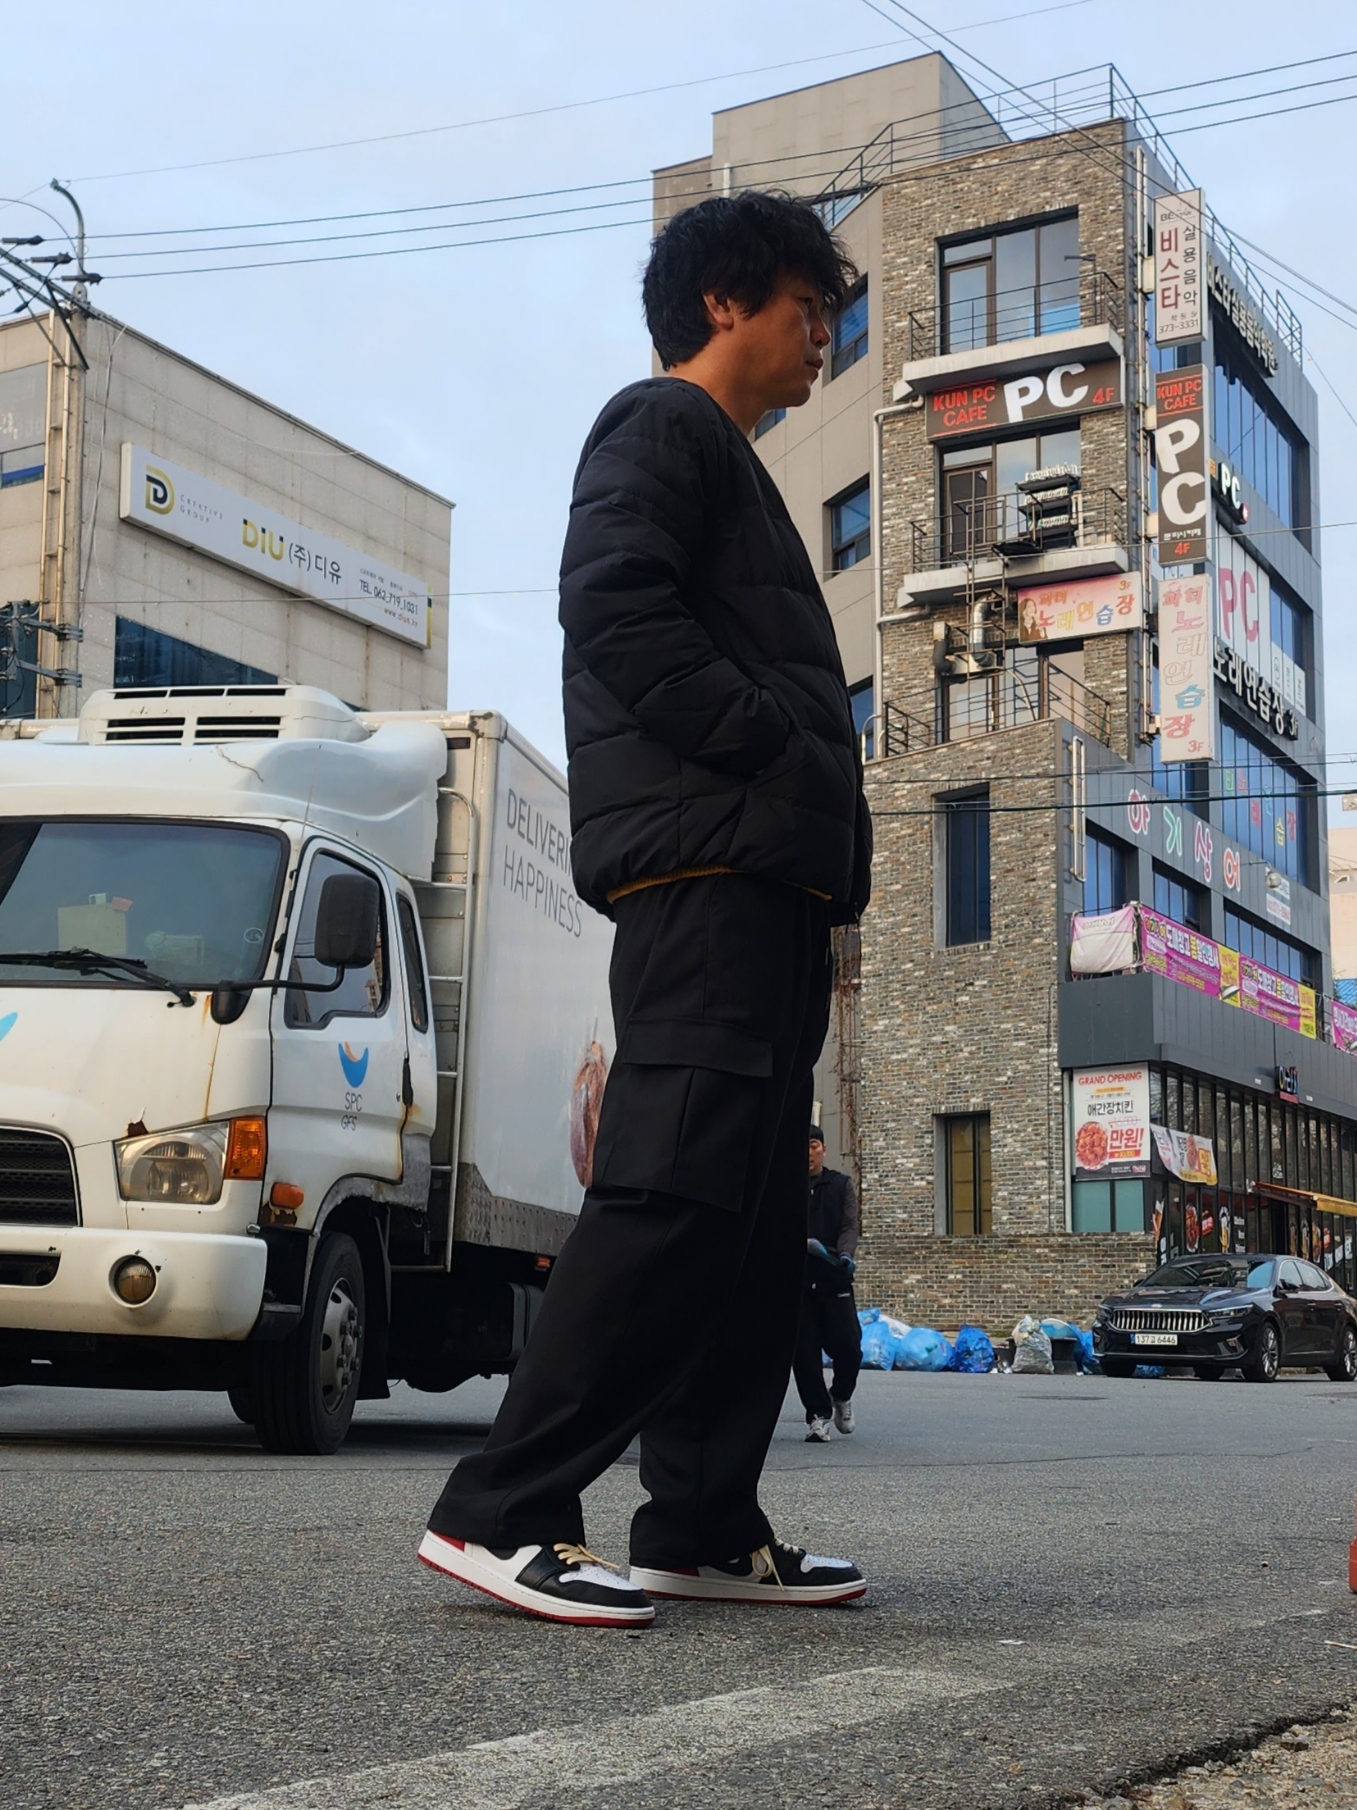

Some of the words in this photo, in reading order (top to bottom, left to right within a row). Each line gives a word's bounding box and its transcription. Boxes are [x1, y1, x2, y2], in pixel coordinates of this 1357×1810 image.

[1160, 226, 1181, 309] 비스타
[1183, 224, 1198, 306] 실용음악
[1159, 318, 1199, 333] 373-3331
[933, 392, 967, 411] KUN
[972, 385, 996, 403] PC
[1003, 363, 1089, 423] PC
[1093, 388, 1114, 404] 4F
[1157, 384, 1183, 399] KUN
[1185, 379, 1202, 393] PC
[1164, 393, 1197, 410] CAFE
[943, 405, 987, 427] CAFE
[1155, 419, 1207, 525] PC
[1221, 462, 1240, 510] PC
[180, 494, 223, 520] CREATIVE
[180, 505, 209, 524] GROUP
[1174, 542, 1190, 555] 4F
[1036, 593, 1135, 630] 노래연습장
[1218, 567, 1259, 642] PC
[1163, 611, 1208, 739] 노래연습장
[1213, 634, 1285, 735] 노래연습장
[1188, 739, 1204, 752] 3F
[507, 788, 572, 876] DELIVERI
[1128, 788, 1241, 892] 아기상어
[503, 845, 582, 938] HAPPINESS
[1078, 1075, 1105, 1086] GRAND
[1107, 1071, 1142, 1083] OPENING
[344, 1091, 363, 1112] SPC
[1087, 1100, 1133, 1117] 애간장치킨
[341, 1114, 357, 1131] GFS
[1109, 1127, 1144, 1150] 만원!
